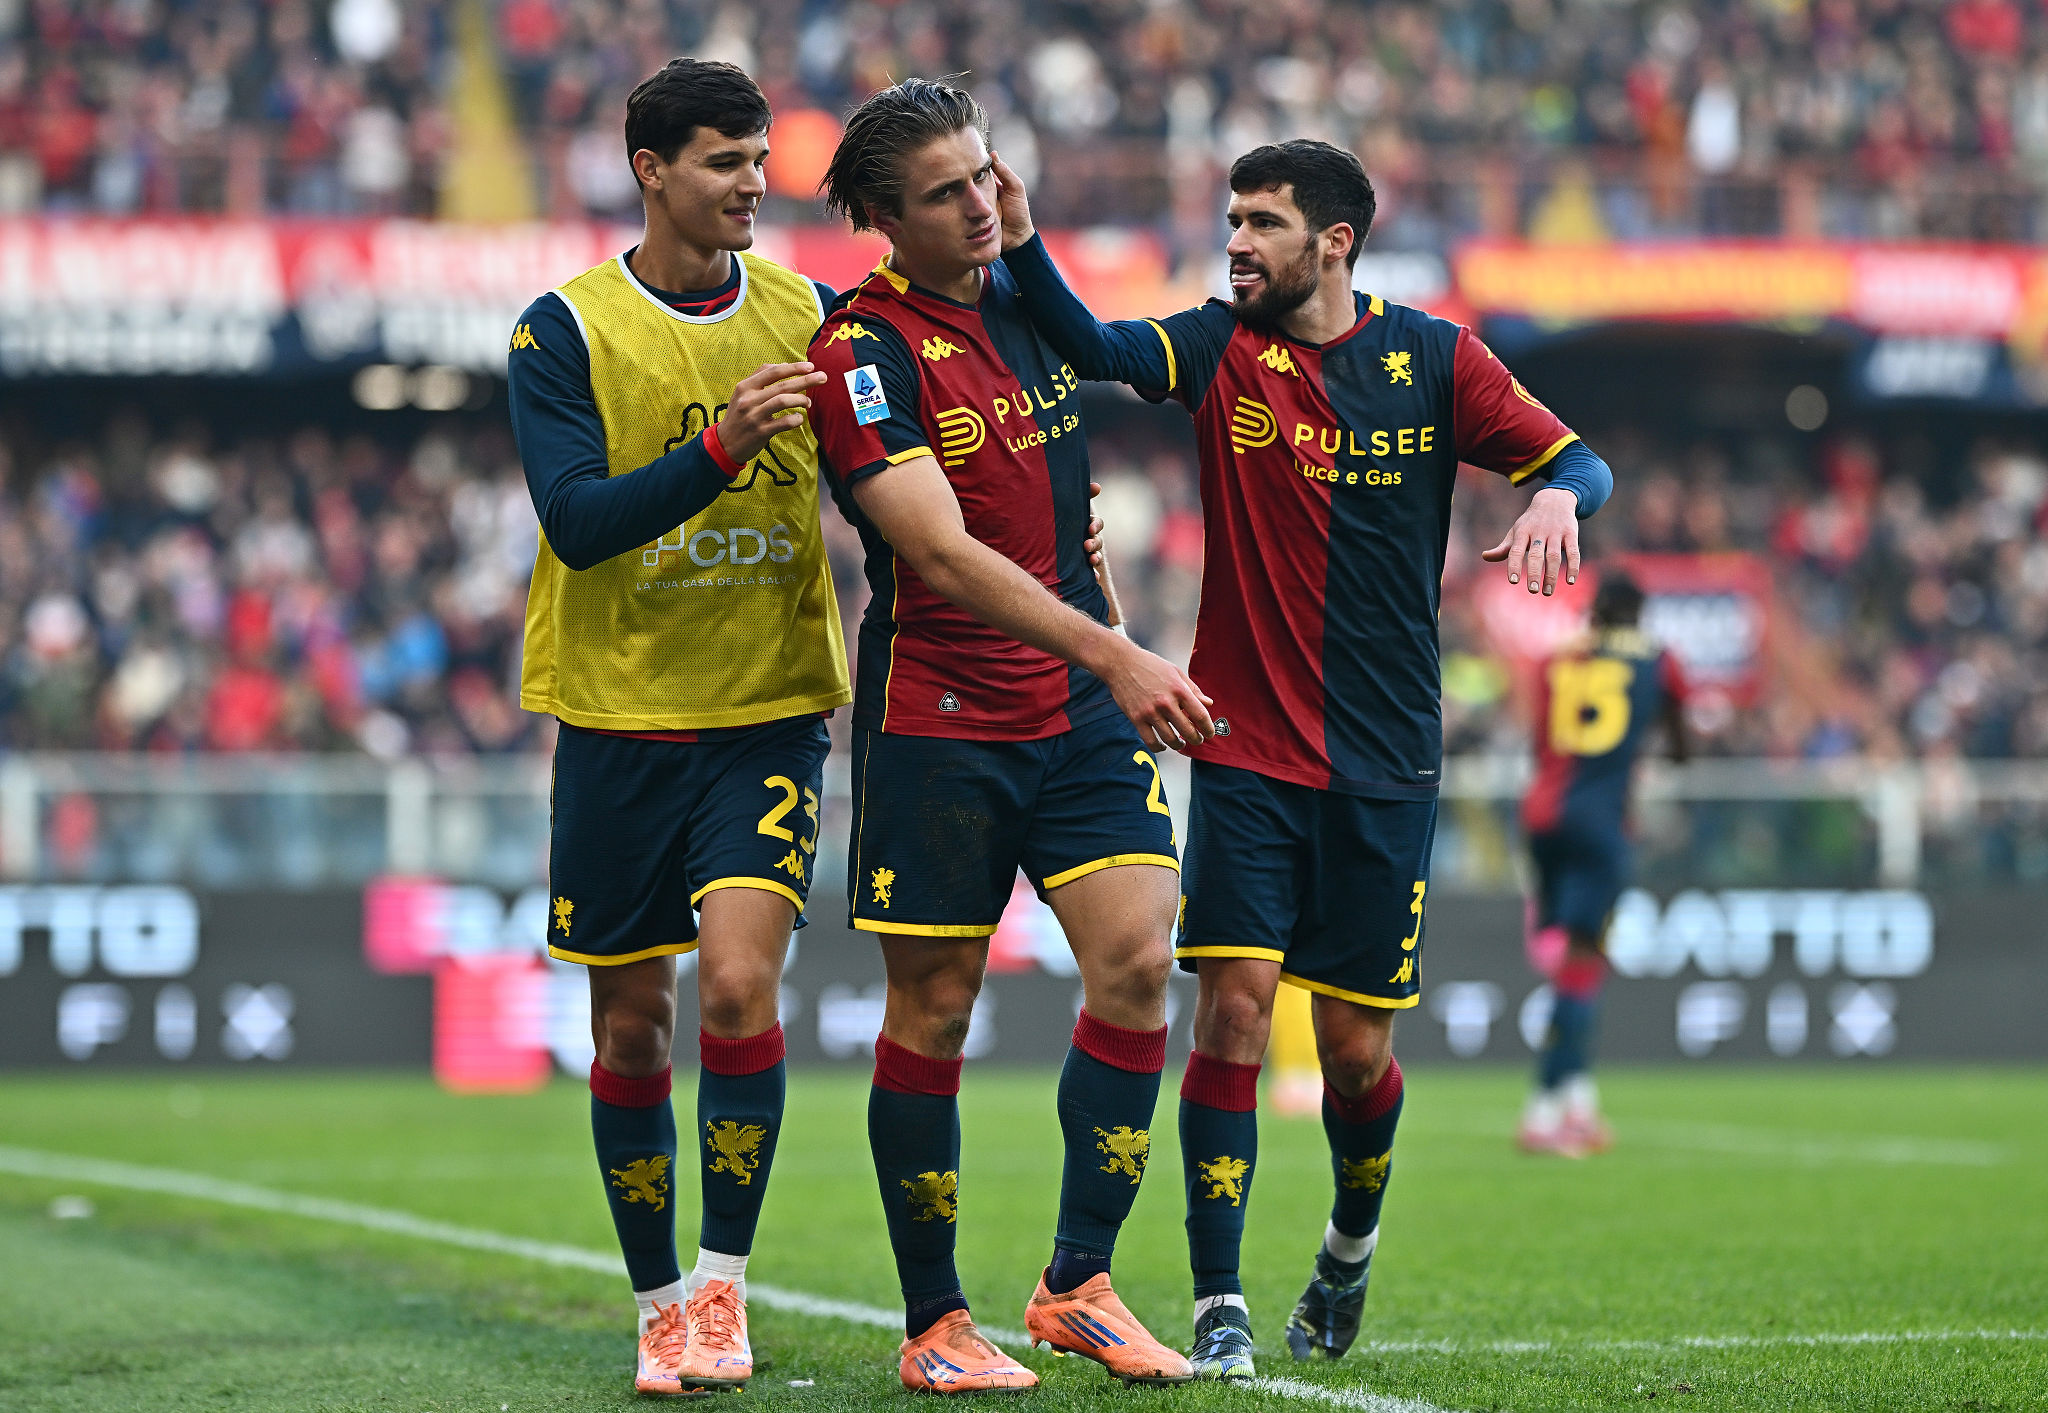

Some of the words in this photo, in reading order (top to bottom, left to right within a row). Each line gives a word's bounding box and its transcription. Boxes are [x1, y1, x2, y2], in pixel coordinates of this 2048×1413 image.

[857, 396, 874, 405] SERIE
[993, 362, 1078, 424] PULSE
[1006, 430, 1048, 453] Luce
[1051, 425, 1062, 439] e
[1294, 422, 1435, 457] PULSEE
[1294, 458, 1340, 483] Luce
[1346, 471, 1359, 485] e
[1365, 469, 1402, 486] Gas
[688, 523, 795, 568] CDS
[636, 582, 651, 591] LA
[656, 580, 679, 590] TUA
[682, 578, 714, 588] CASA
[717, 577, 755, 587] DELLA
[758, 574, 798, 585] SALUTE
[757, 775, 819, 855] 23
[1400, 881, 1426, 951] 3
